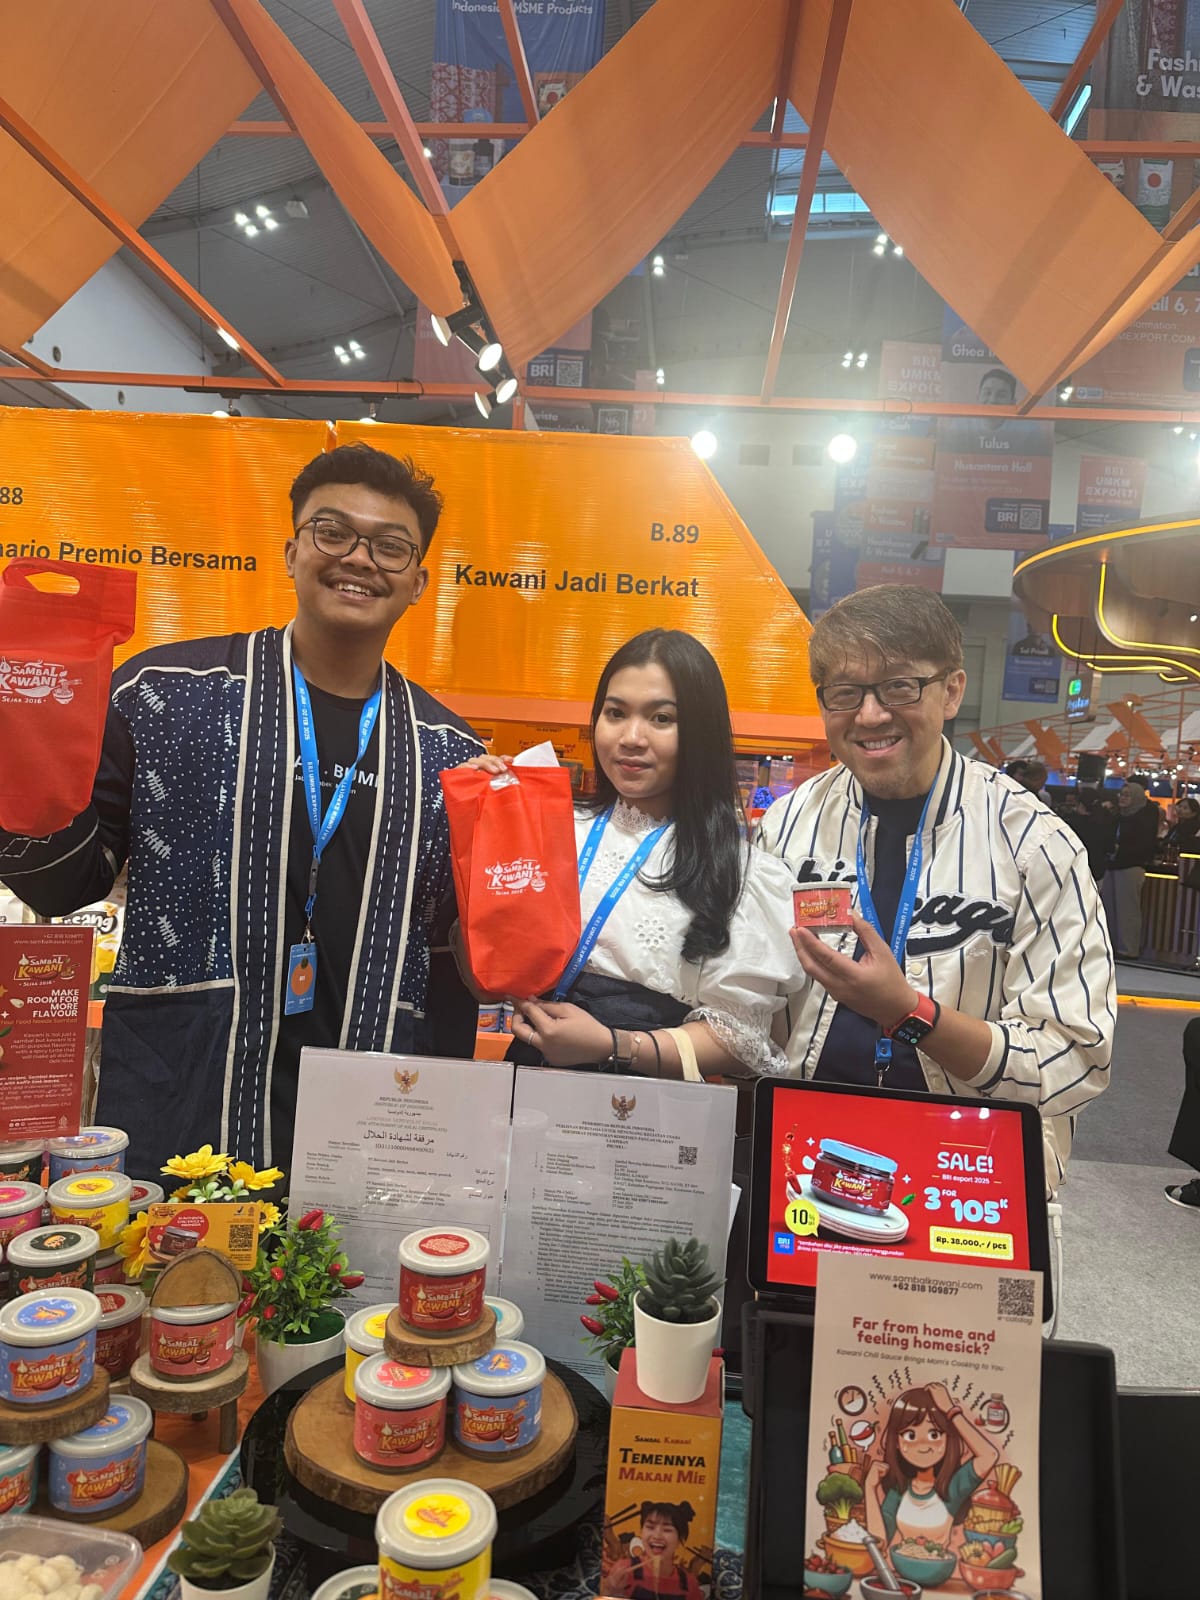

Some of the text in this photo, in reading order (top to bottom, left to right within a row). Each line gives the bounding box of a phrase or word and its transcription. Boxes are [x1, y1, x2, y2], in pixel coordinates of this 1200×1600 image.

[512, 3, 543, 14] MSME
[547, 2, 593, 15] Products
[1136, 75, 1152, 97] &
[1151, 296, 1170, 312] all
[952, 344, 984, 358] Ghea
[530, 363, 554, 378] BRI
[978, 436, 1010, 450] Tulus
[1011, 460, 1033, 474] Hall
[996, 511, 1019, 523] BRI
[650, 522, 700, 544] B.89
[59, 541, 143, 564] Premio
[150, 545, 257, 572] Bersama
[455, 563, 699, 598] Kawani Jadi Berkat
[12, 665, 58, 678] SAMBAL
[0, 673, 57, 691] KAWANI
[503, 861, 535, 874] SAMBAL
[491, 868, 534, 888] KAWANI
[30, 956, 64, 966] SAMBAL
[18, 963, 63, 978] KAWANI
[27, 995, 79, 1004] ROOM FOR
[51, 988, 79, 997] MAKE
[33, 1009, 78, 1018] FLAVOUR
[50, 1002, 78, 1011] MORE
[363, 1129, 387, 1140] الحلال
[937, 1151, 994, 1174] SALE!
[941, 1173, 954, 1182] BRI
[974, 1176, 990, 1185] 2025
[924, 1186, 941, 1210] 3
[941, 1189, 957, 1198] FOR
[791, 1209, 808, 1225] 10
[936, 1235, 950, 1246] Rp.
[992, 1242, 1008, 1251] pcs
[869, 1272, 983, 1291] www.sambalkawani.com
[893, 1283, 910, 1291] +62
[910, 1284, 927, 1293] 818
[427, 1290, 461, 1301] SAMBAL
[417, 1299, 460, 1314] KAWANI
[852, 1316, 996, 1343] Far from home and
[159, 1343, 198, 1359] KAWANI
[166, 1338, 199, 1348] SAMBAL
[857, 1330, 990, 1356] feeling homesick?
[29, 1360, 67, 1373] SAMBAL
[836, 1348, 862, 1358] Kawani
[880, 1352, 902, 1361] Sauce
[904, 1354, 926, 1365] Brings
[951, 1358, 980, 1370] Cooking
[981, 1362, 989, 1370] to
[991, 1363, 1005, 1372] You
[17, 1367, 67, 1386] KAWANI
[471, 1411, 507, 1423] SAMBAL
[393, 1421, 428, 1437] SAMBAL
[463, 1418, 506, 1434] KAWANI
[381, 1431, 428, 1449] KAWANI
[634, 1434, 692, 1445] SAMBAL KAWANI
[619, 1447, 706, 1468] TEMENNYA
[88, 1465, 126, 1483] SAMBAL
[618, 1467, 672, 1484] MAKAN
[76, 1473, 125, 1498] KAWANI
